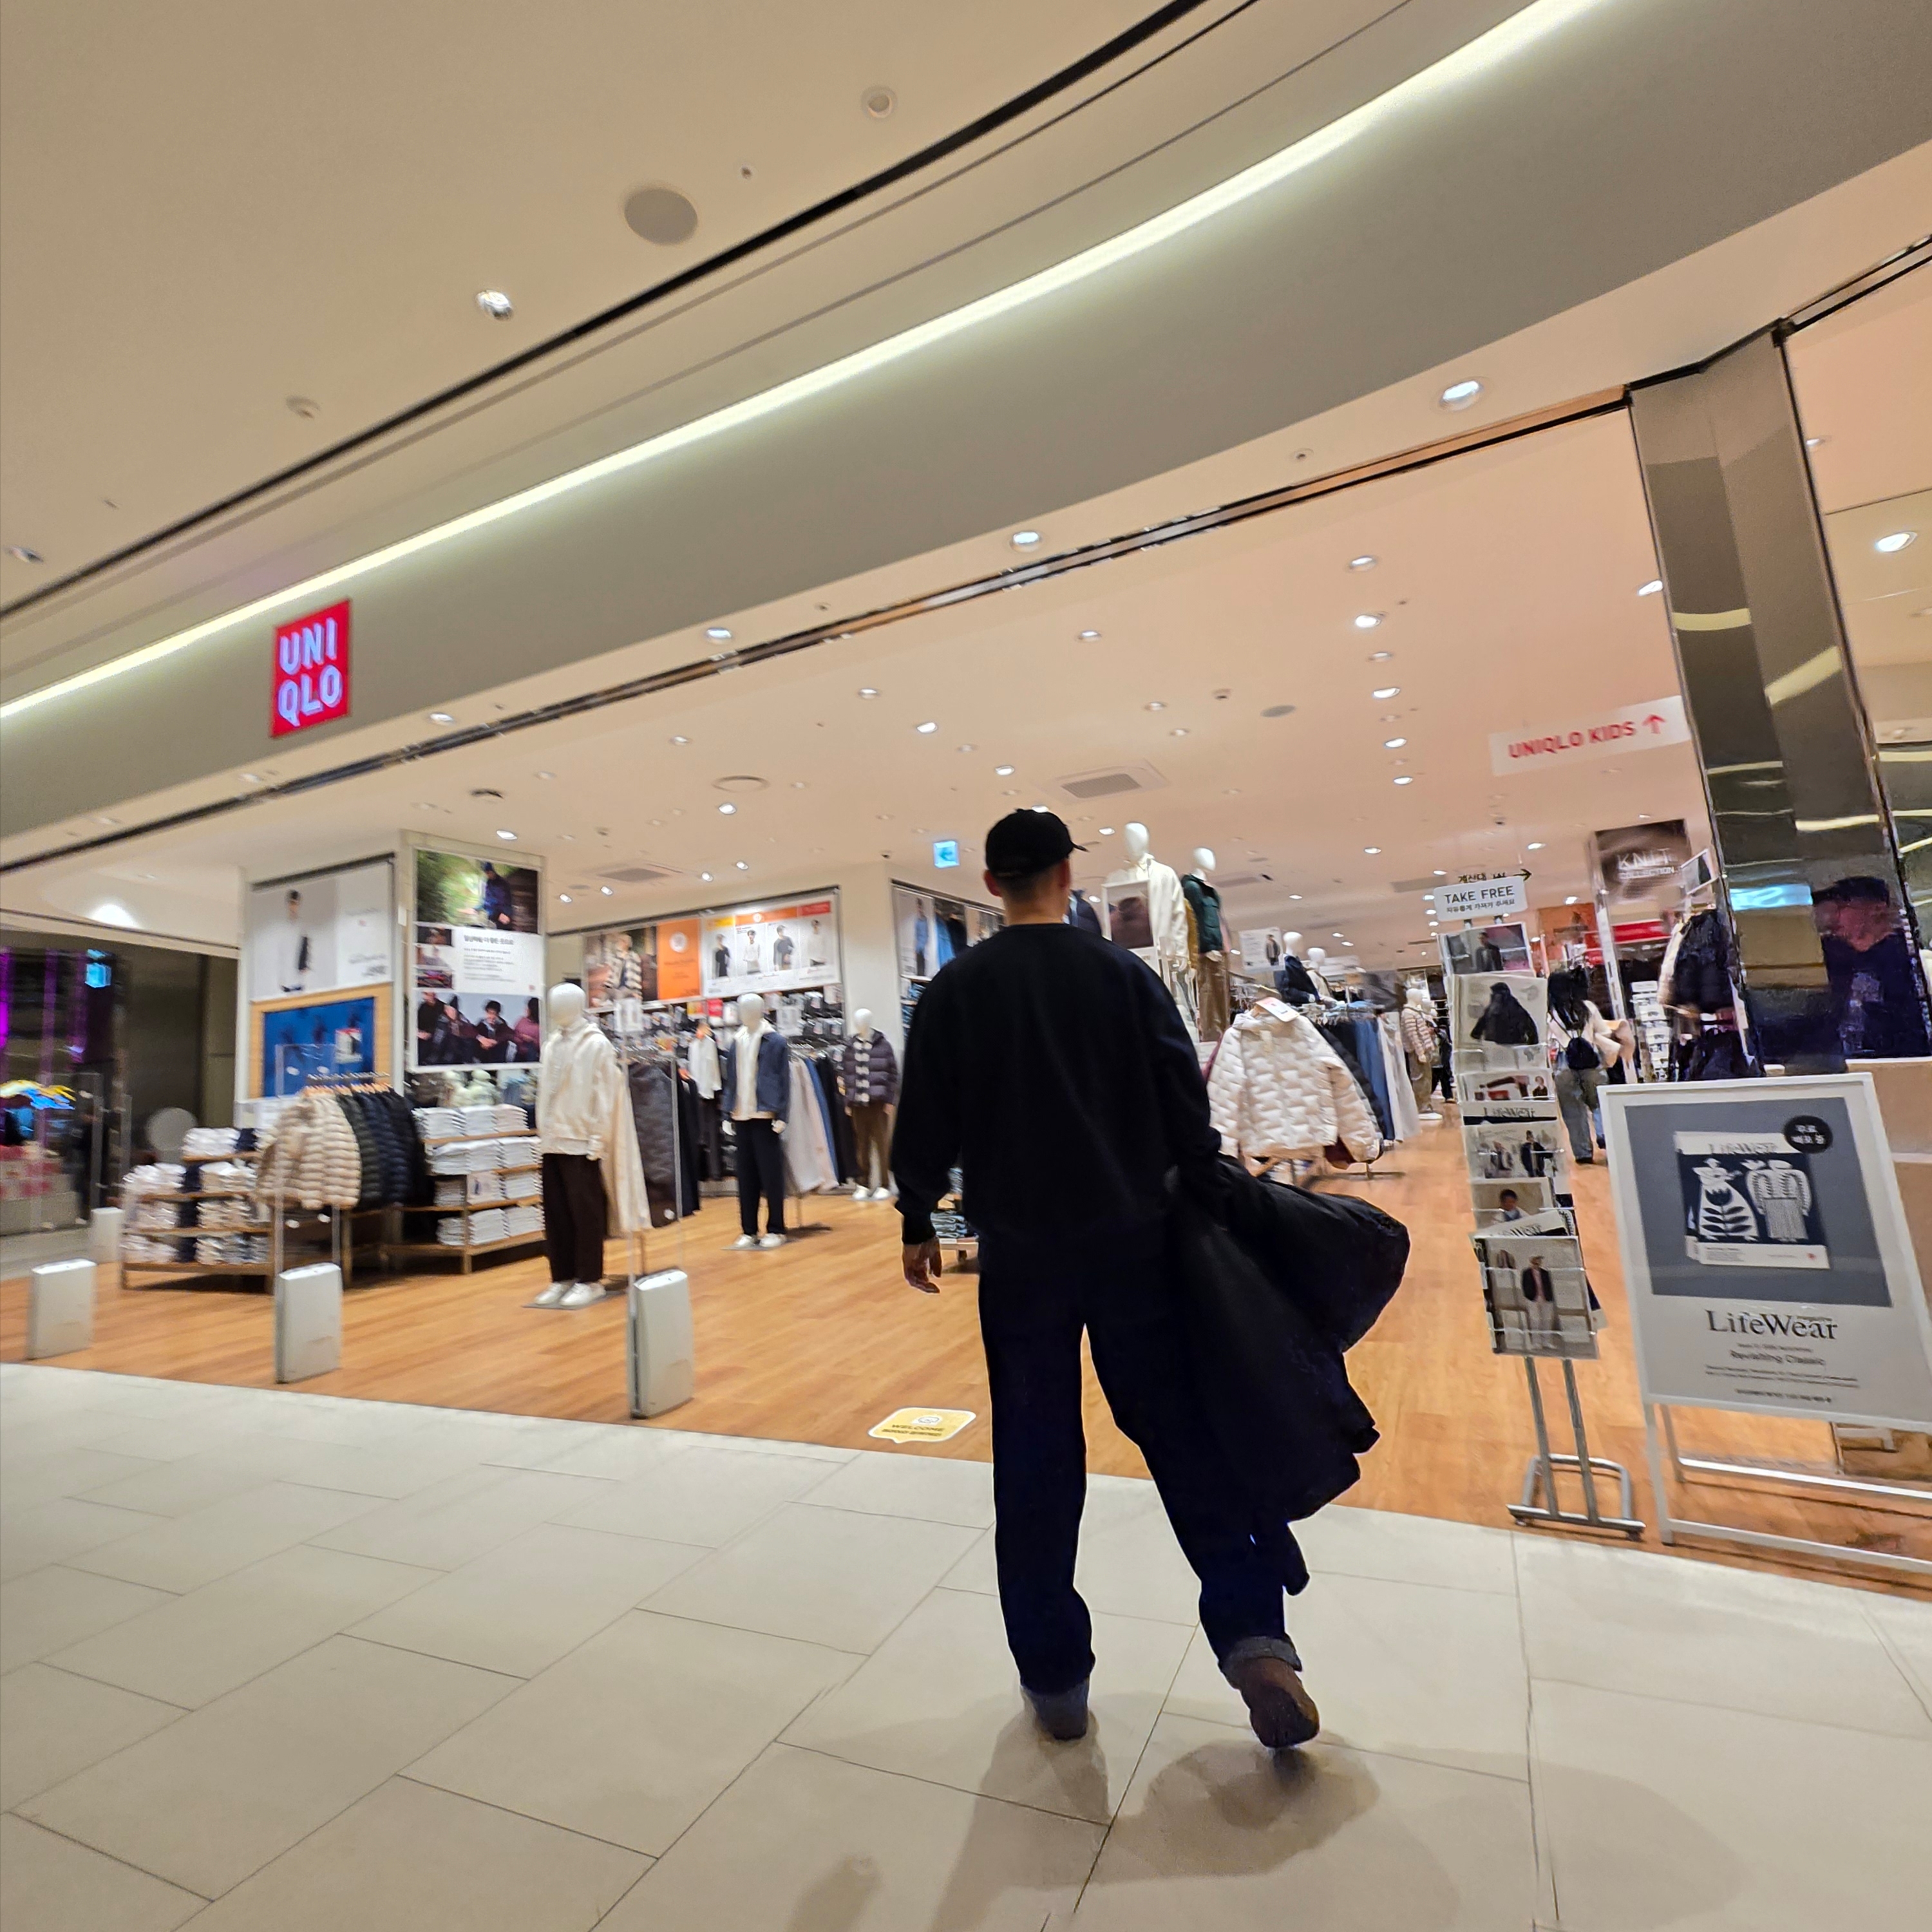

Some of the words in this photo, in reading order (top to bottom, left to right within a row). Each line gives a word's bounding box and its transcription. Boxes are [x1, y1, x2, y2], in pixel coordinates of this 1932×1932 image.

[279, 616, 337, 675] UNI
[278, 664, 343, 727] QLO
[1508, 731, 1584, 759] UNIQLO
[1588, 721, 1636, 743] KIDS
[1444, 891, 1477, 904] TAKE
[1481, 885, 1515, 900] FREE
[1705, 1309, 1838, 1340] LifeWear
